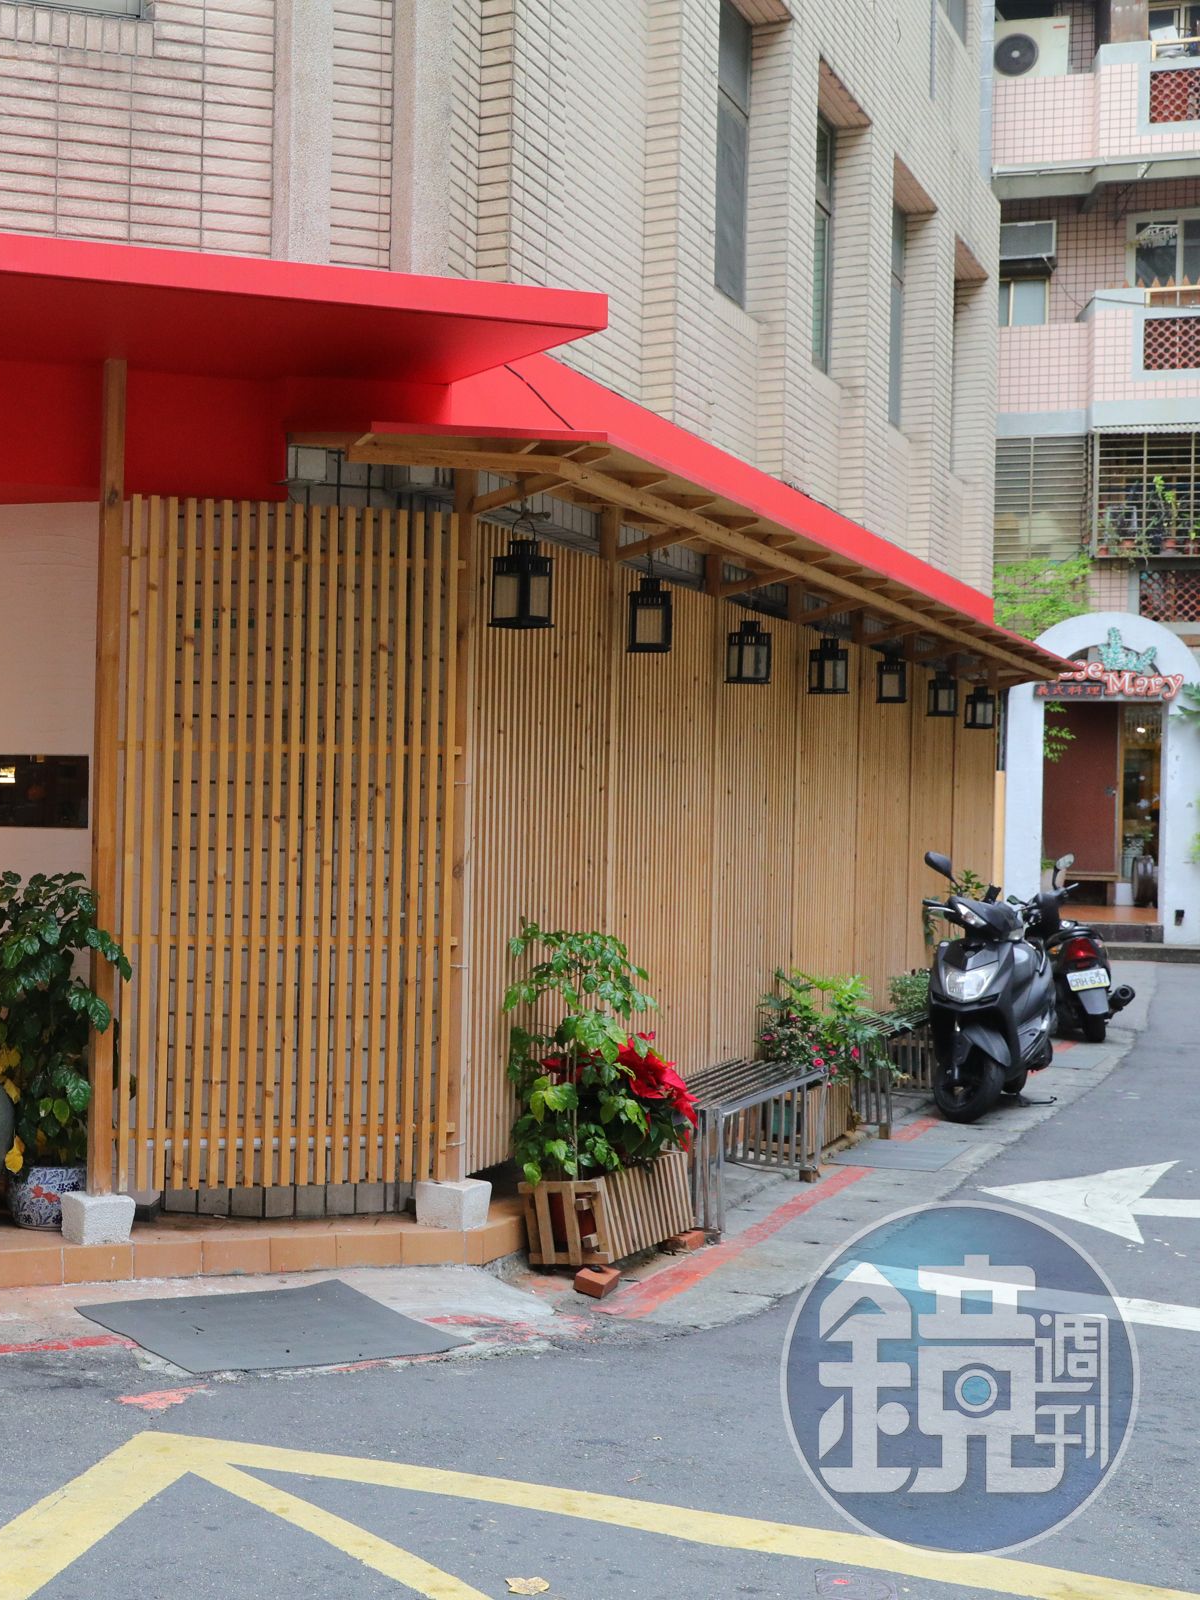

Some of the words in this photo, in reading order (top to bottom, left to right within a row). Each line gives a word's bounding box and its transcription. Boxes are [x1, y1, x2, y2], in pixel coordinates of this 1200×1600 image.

[1037, 684, 1101, 696] 義式料理
[1102, 670, 1184, 700] Mary
